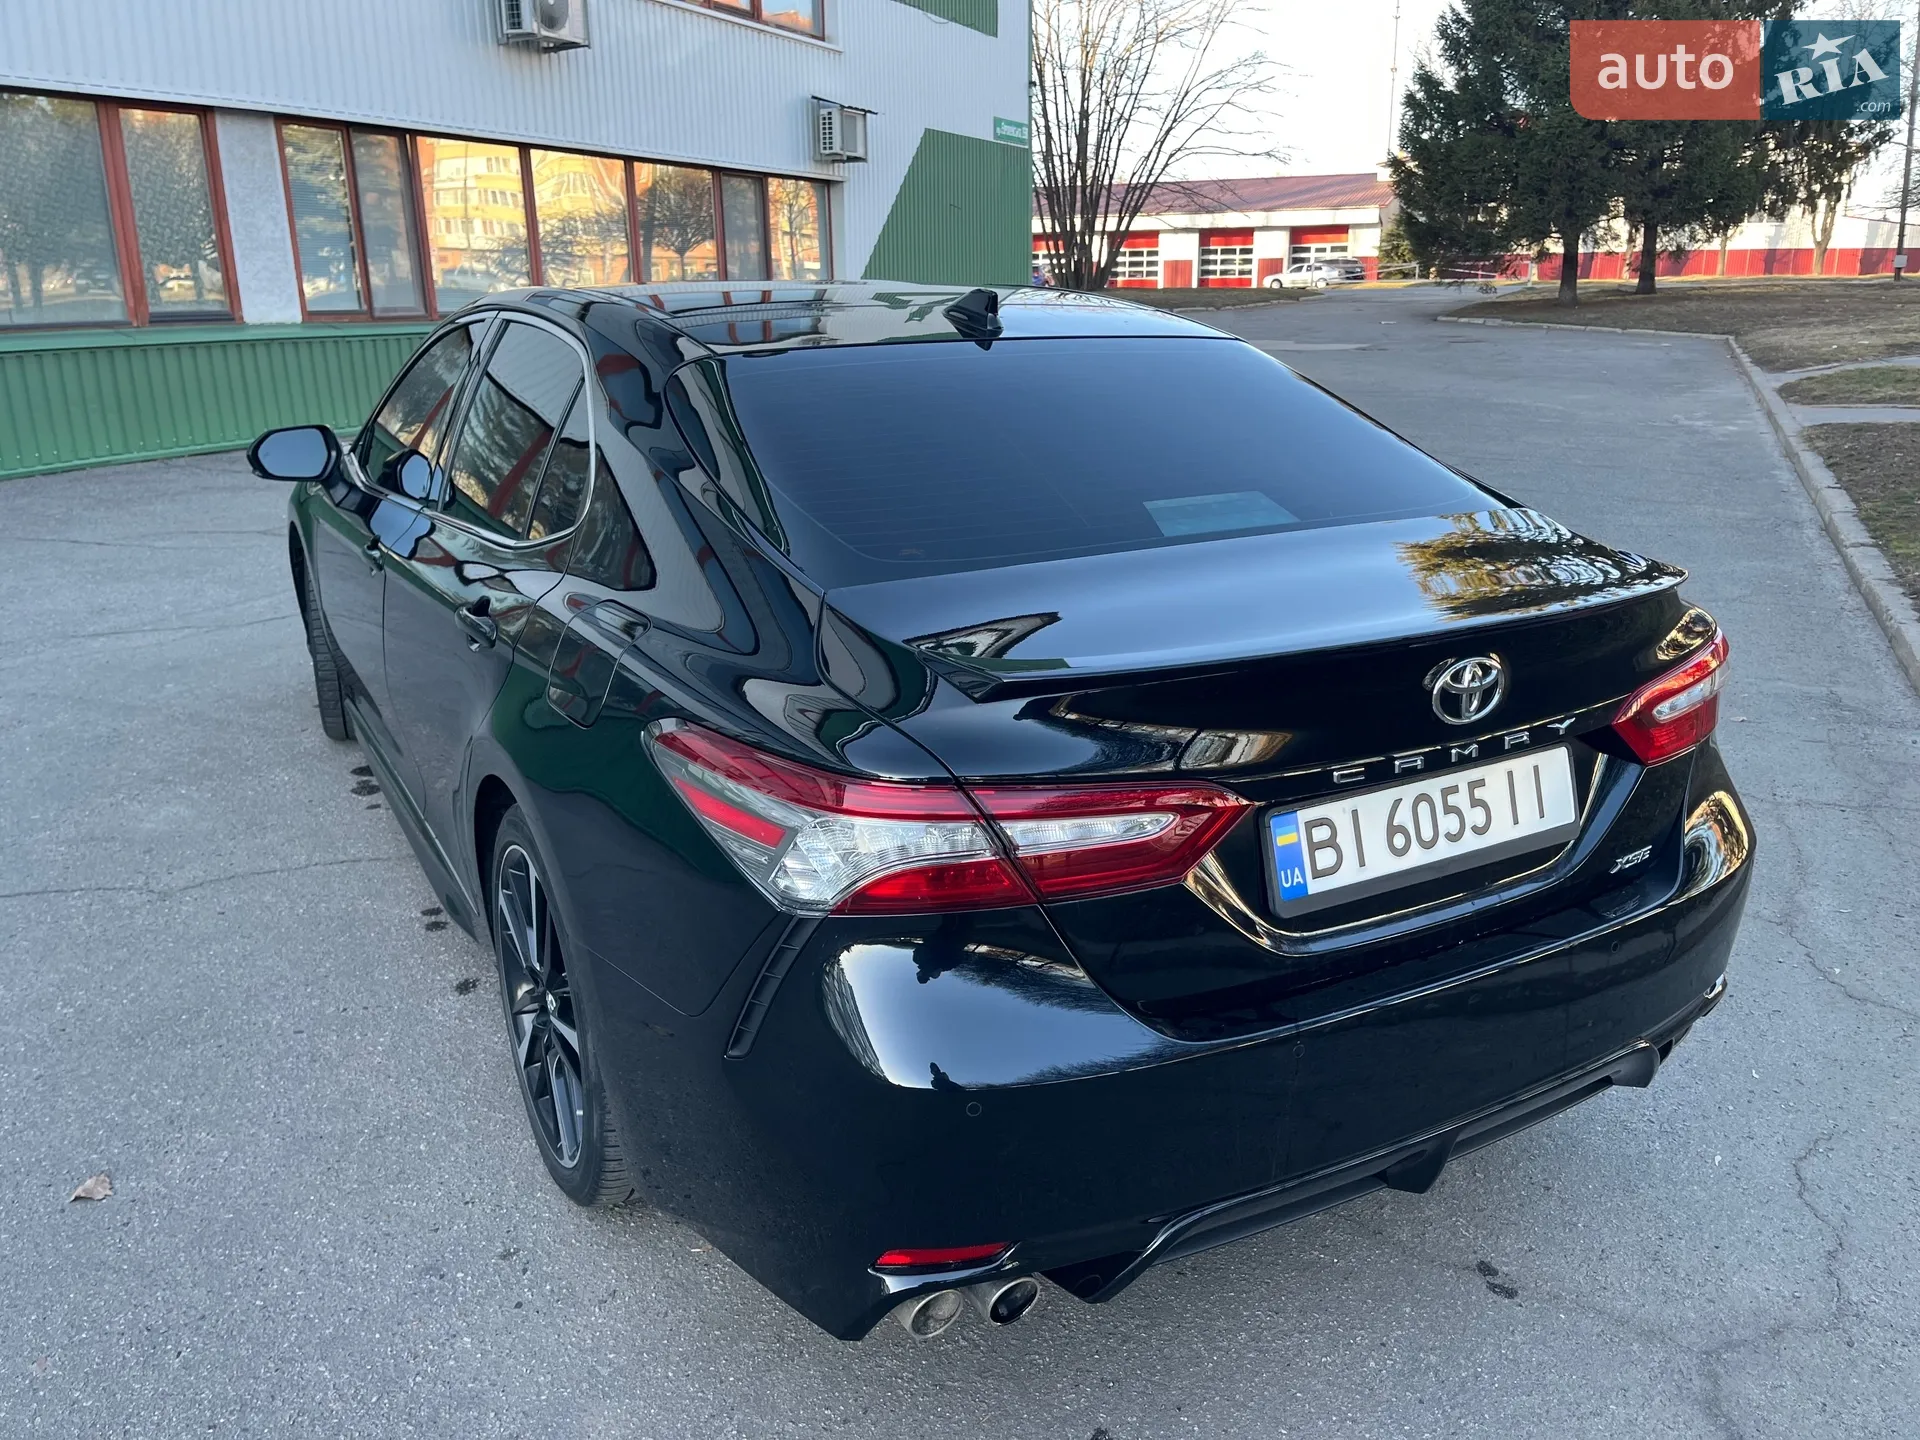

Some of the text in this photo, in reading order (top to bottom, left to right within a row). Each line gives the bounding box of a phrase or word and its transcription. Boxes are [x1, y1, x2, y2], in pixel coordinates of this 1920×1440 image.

[1333, 717, 1576, 784] CAMRY
[1304, 764, 1545, 880] BI 6055 II
[1281, 866, 1304, 889] UA
[1608, 845, 1653, 874] XSE
